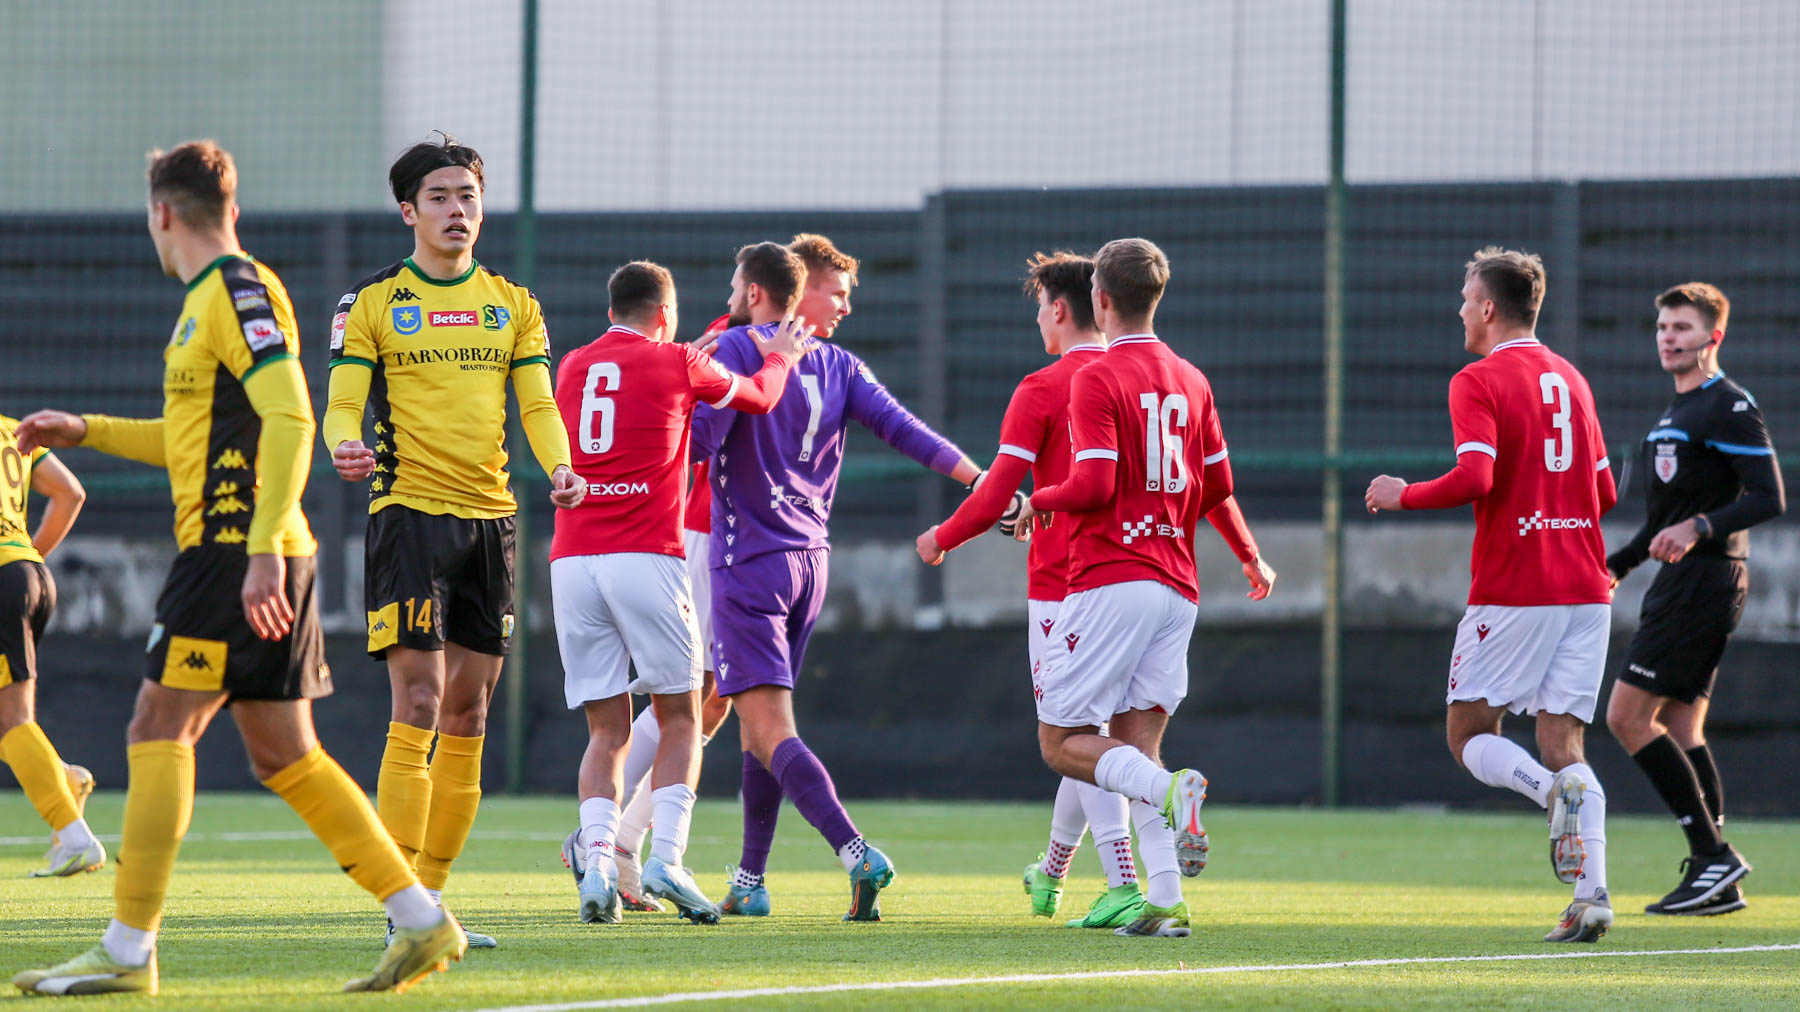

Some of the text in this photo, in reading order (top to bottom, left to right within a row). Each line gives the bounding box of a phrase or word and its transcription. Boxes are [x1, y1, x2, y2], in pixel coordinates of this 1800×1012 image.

[433, 313, 475, 324] Betclic
[393, 347, 511, 366] TARNOBRZEG
[578, 361, 621, 454] 6
[798, 374, 823, 462] 1
[1539, 371, 1574, 472] 3
[1139, 392, 1188, 493] 16
[0, 447, 24, 512] 9
[1542, 517, 1593, 529] TEXOM
[405, 597, 432, 633] 14
